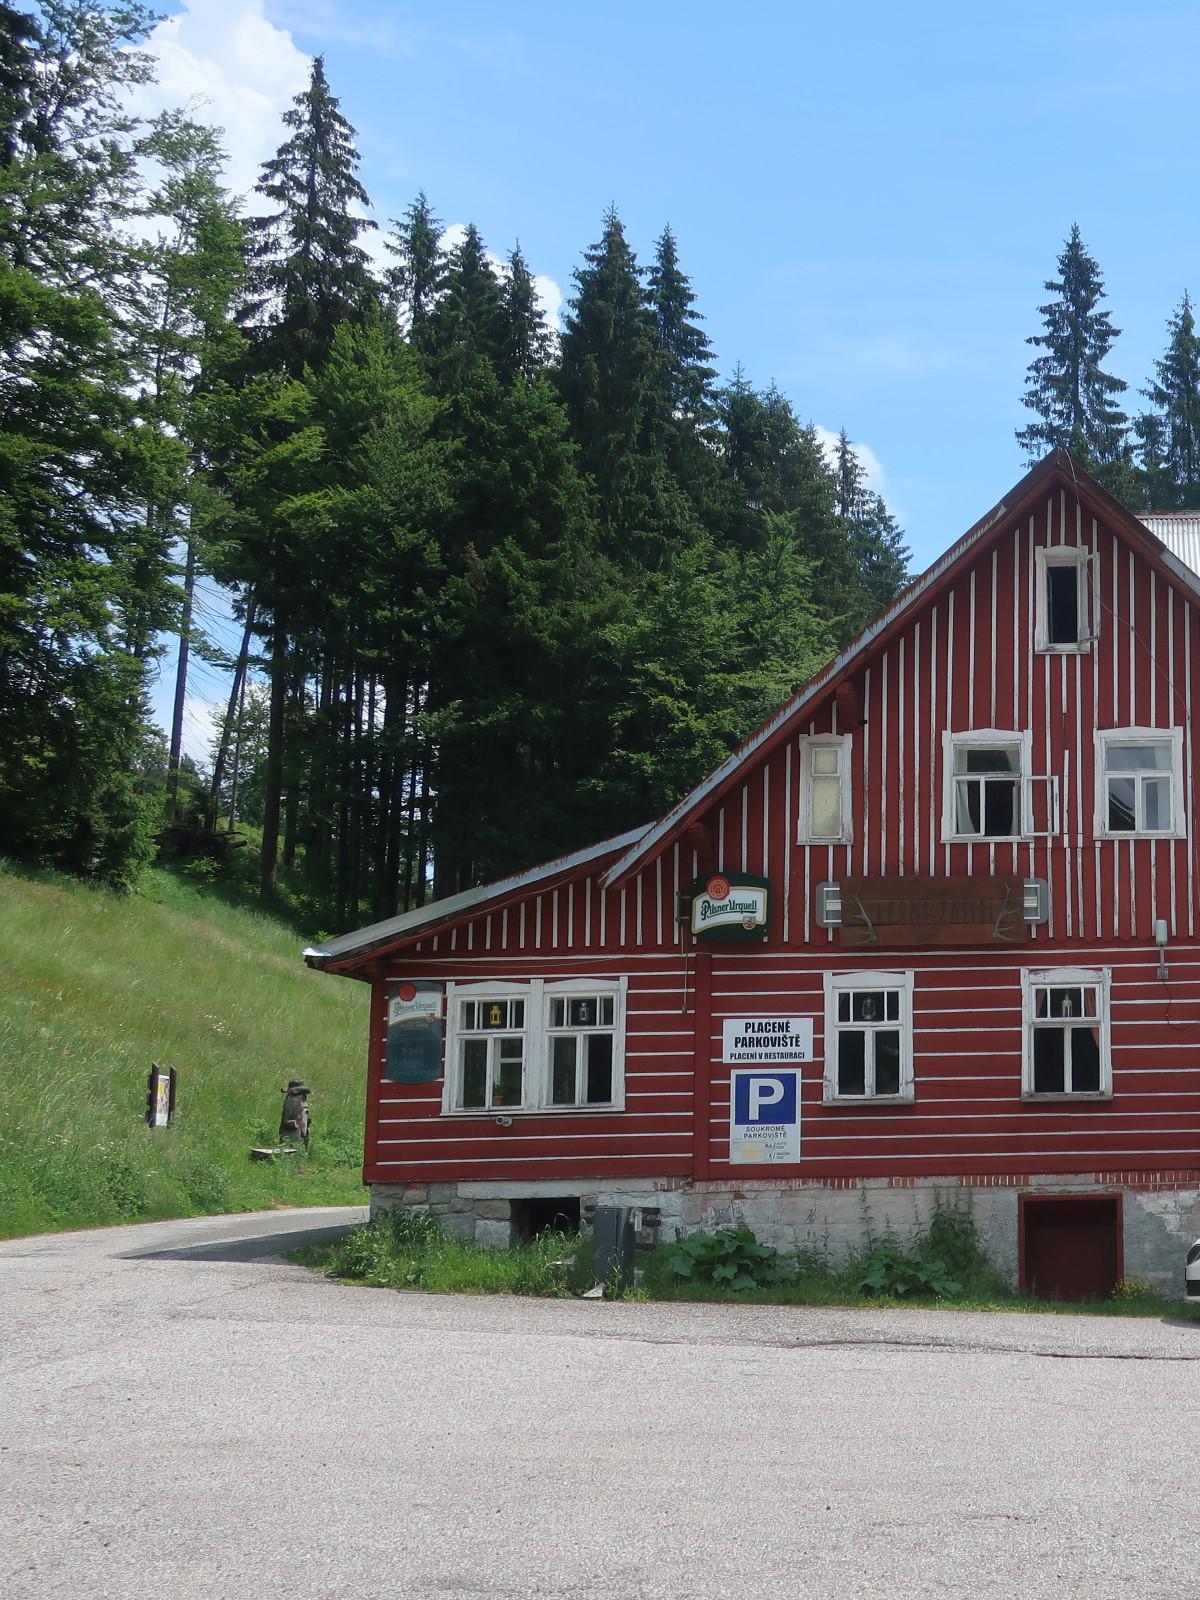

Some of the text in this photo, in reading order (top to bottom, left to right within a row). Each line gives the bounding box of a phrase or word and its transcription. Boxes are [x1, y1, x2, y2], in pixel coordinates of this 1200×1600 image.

[701, 899, 758, 921] Pilsner Urquell
[744, 1019, 791, 1034] PLACENÉ
[734, 1034, 801, 1048] PARKOVIŠTĚ
[758, 1052, 764, 1060] V
[764, 1051, 805, 1060] RESTAURACI
[748, 1078, 785, 1121] P
[743, 1131, 787, 1139] PARKOVIŠTĚ
